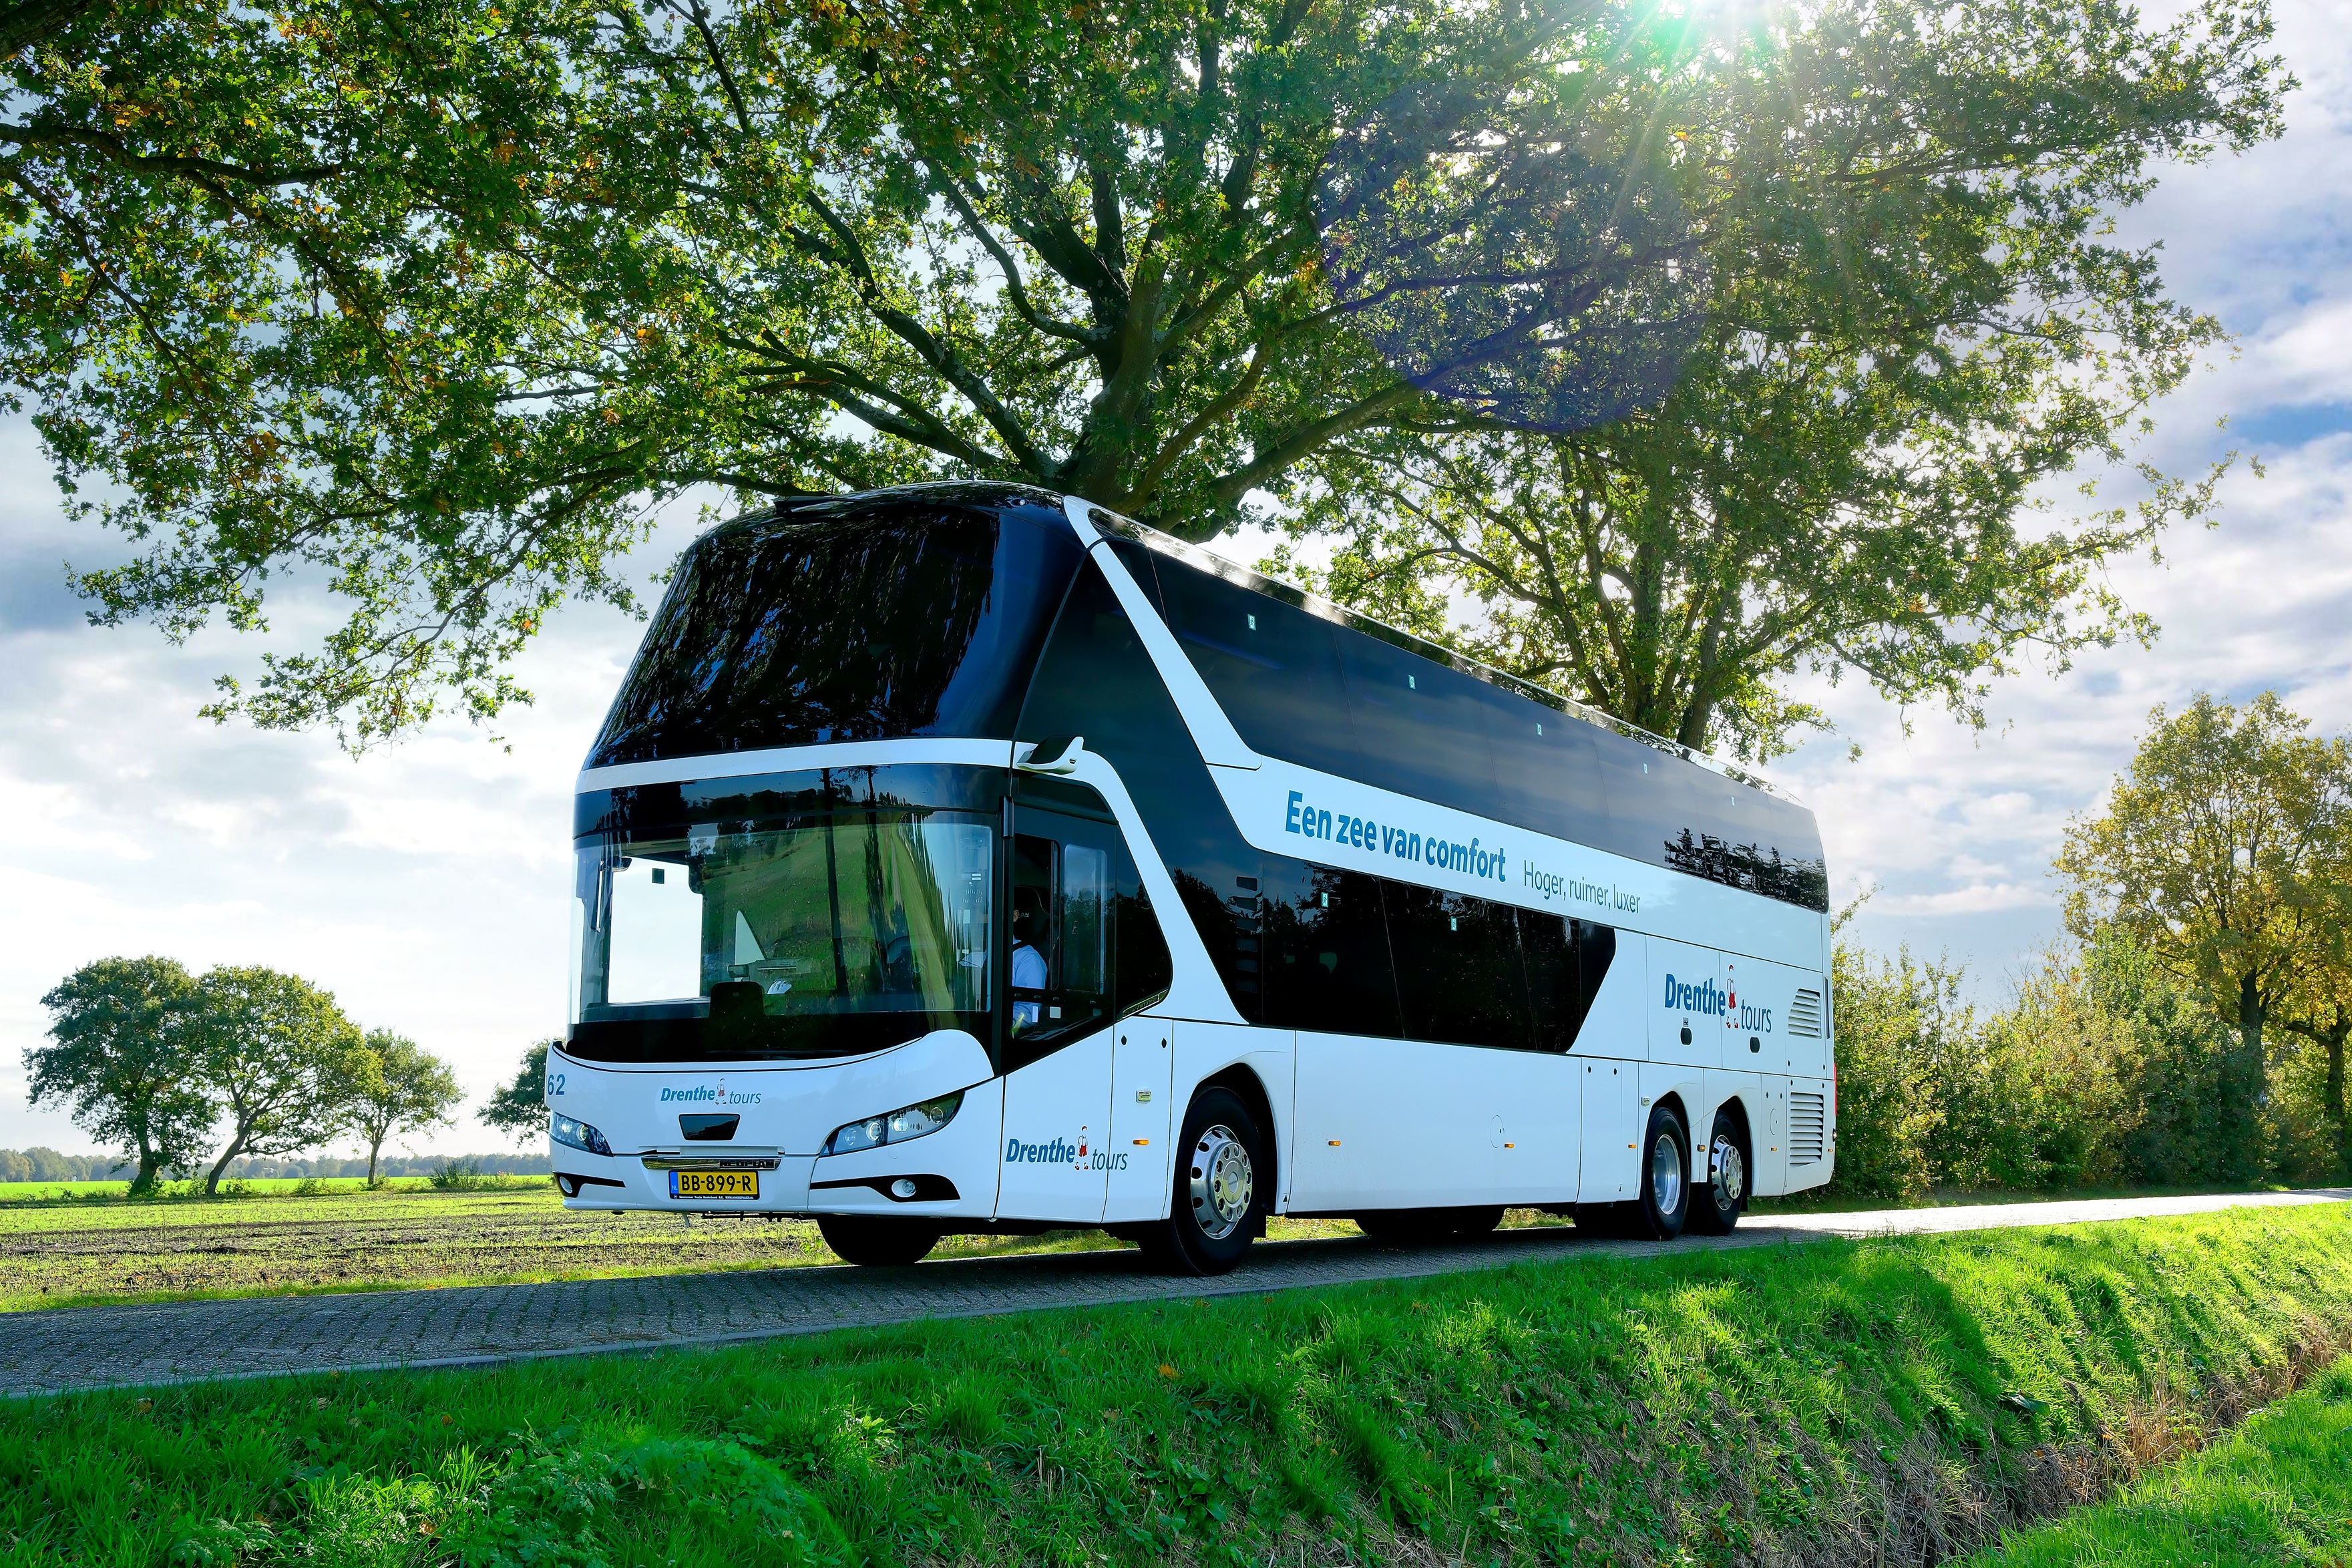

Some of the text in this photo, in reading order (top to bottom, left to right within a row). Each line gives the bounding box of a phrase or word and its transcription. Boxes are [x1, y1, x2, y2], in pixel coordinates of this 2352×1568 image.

[1285, 789, 1506, 882] Een zee van comfort
[1524, 859, 1641, 914] Hoger, ruimer, luxer
[1664, 973, 1772, 1033] Drenthe tours
[548, 1074, 566, 1095] 62
[660, 1085, 762, 1104] Drenthe tours
[719, 1160, 775, 1169] NEOPLAN
[1005, 1137, 1128, 1171] Drenthe tours
[680, 1175, 752, 1191] BB-899-R
